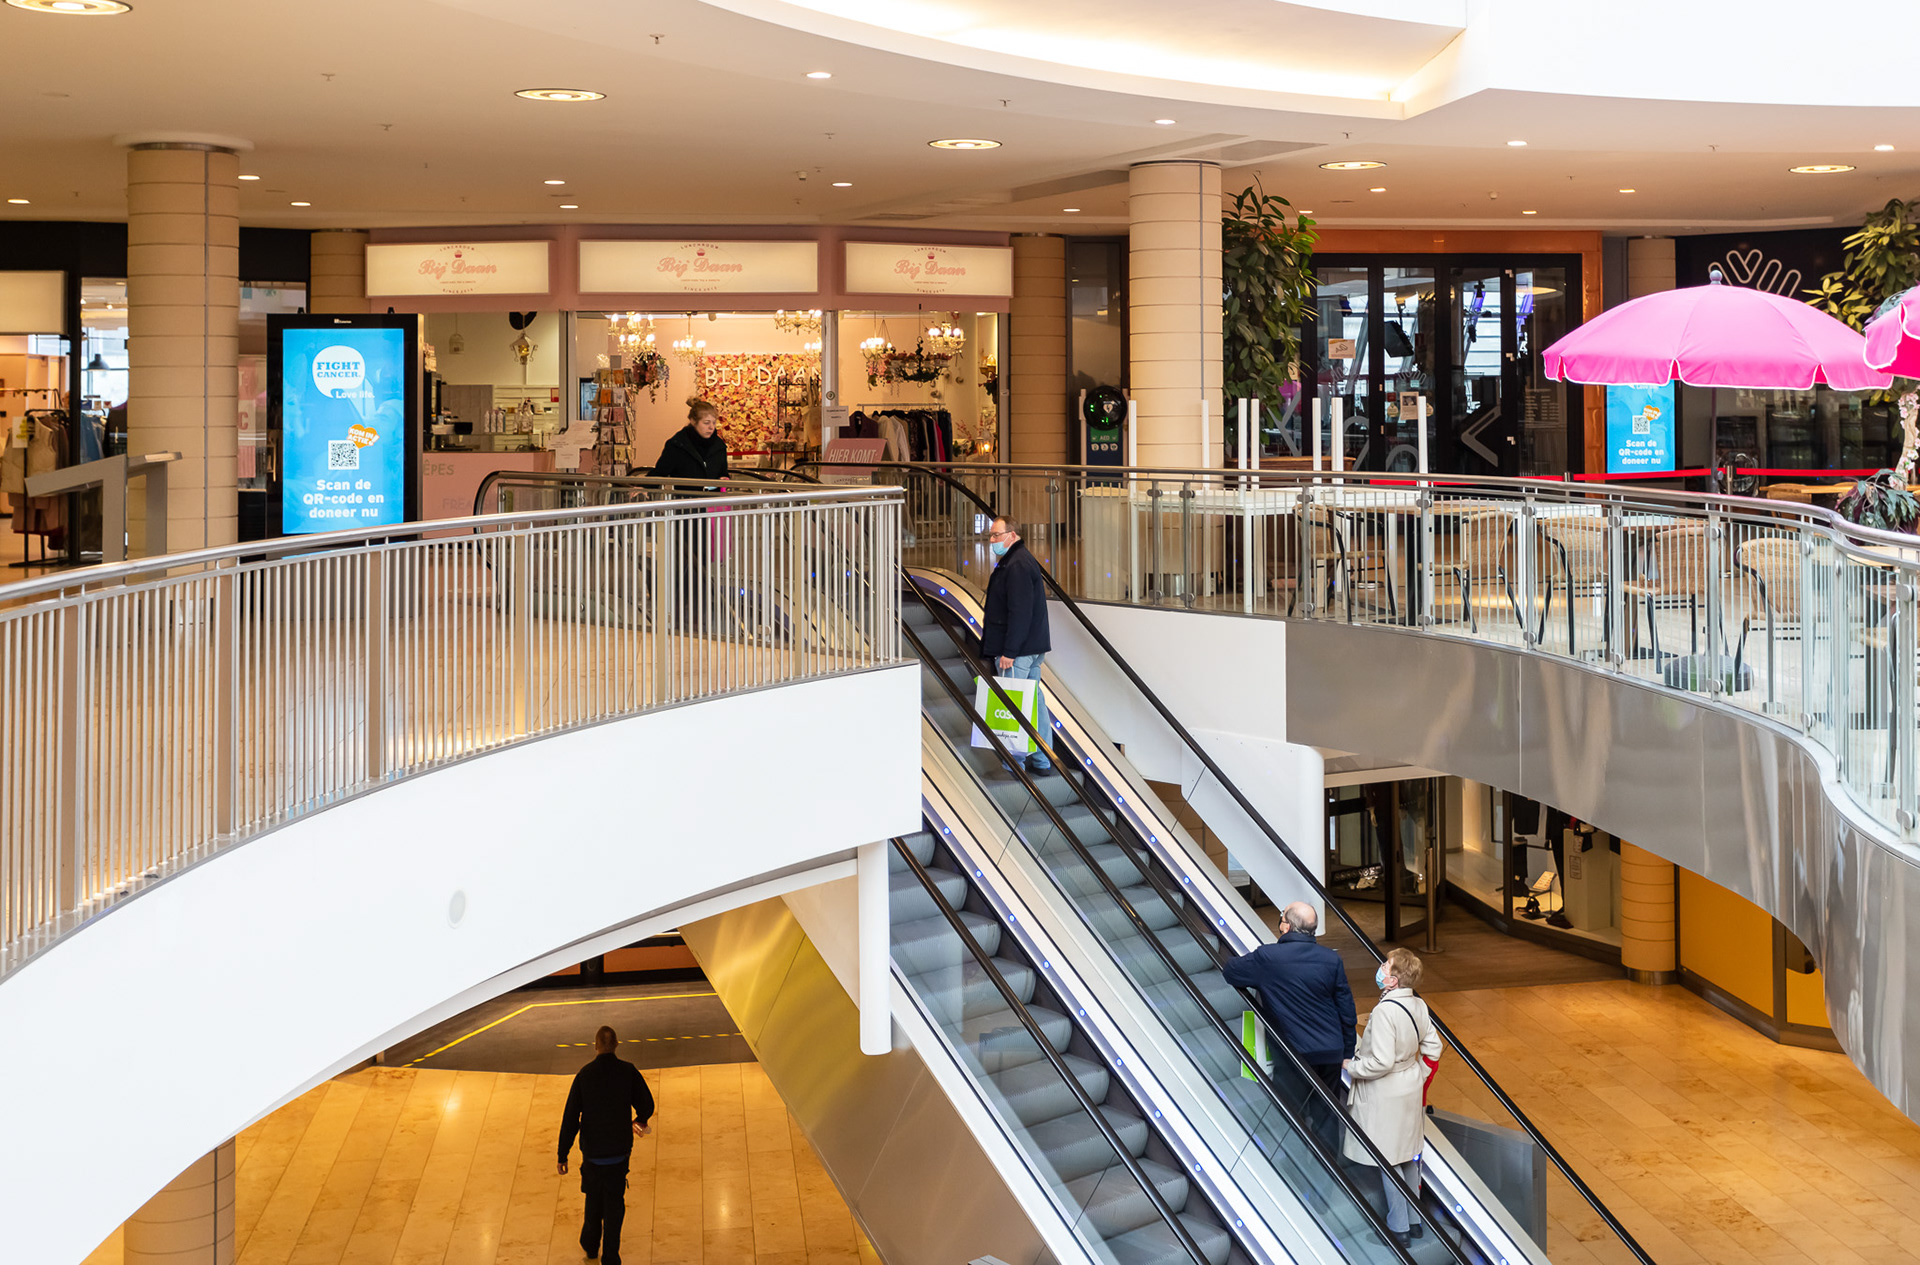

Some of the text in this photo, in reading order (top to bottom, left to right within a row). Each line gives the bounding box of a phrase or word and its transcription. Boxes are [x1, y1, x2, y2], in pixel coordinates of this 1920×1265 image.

[418, 259, 497, 280] Bij Daan
[656, 257, 743, 278] Bij Daan
[894, 259, 966, 280] Bij Daan
[316, 361, 361, 371] FIGHT
[705, 367, 743, 386] BIJ
[335, 390, 357, 399] Love
[349, 428, 374, 439] KOM IN
[1625, 439, 1657, 448] Scan de
[828, 448, 850, 463] HIER
[1618, 448, 1653, 456] QR-code
[1621, 457, 1661, 465] doneer nu
[423, 459, 455, 476] ÊPES
[316, 479, 371, 491] Scan de
[303, 492, 384, 505] QR-code en
[309, 507, 378, 518] doneer nu
[994, 708, 1014, 720] cas
